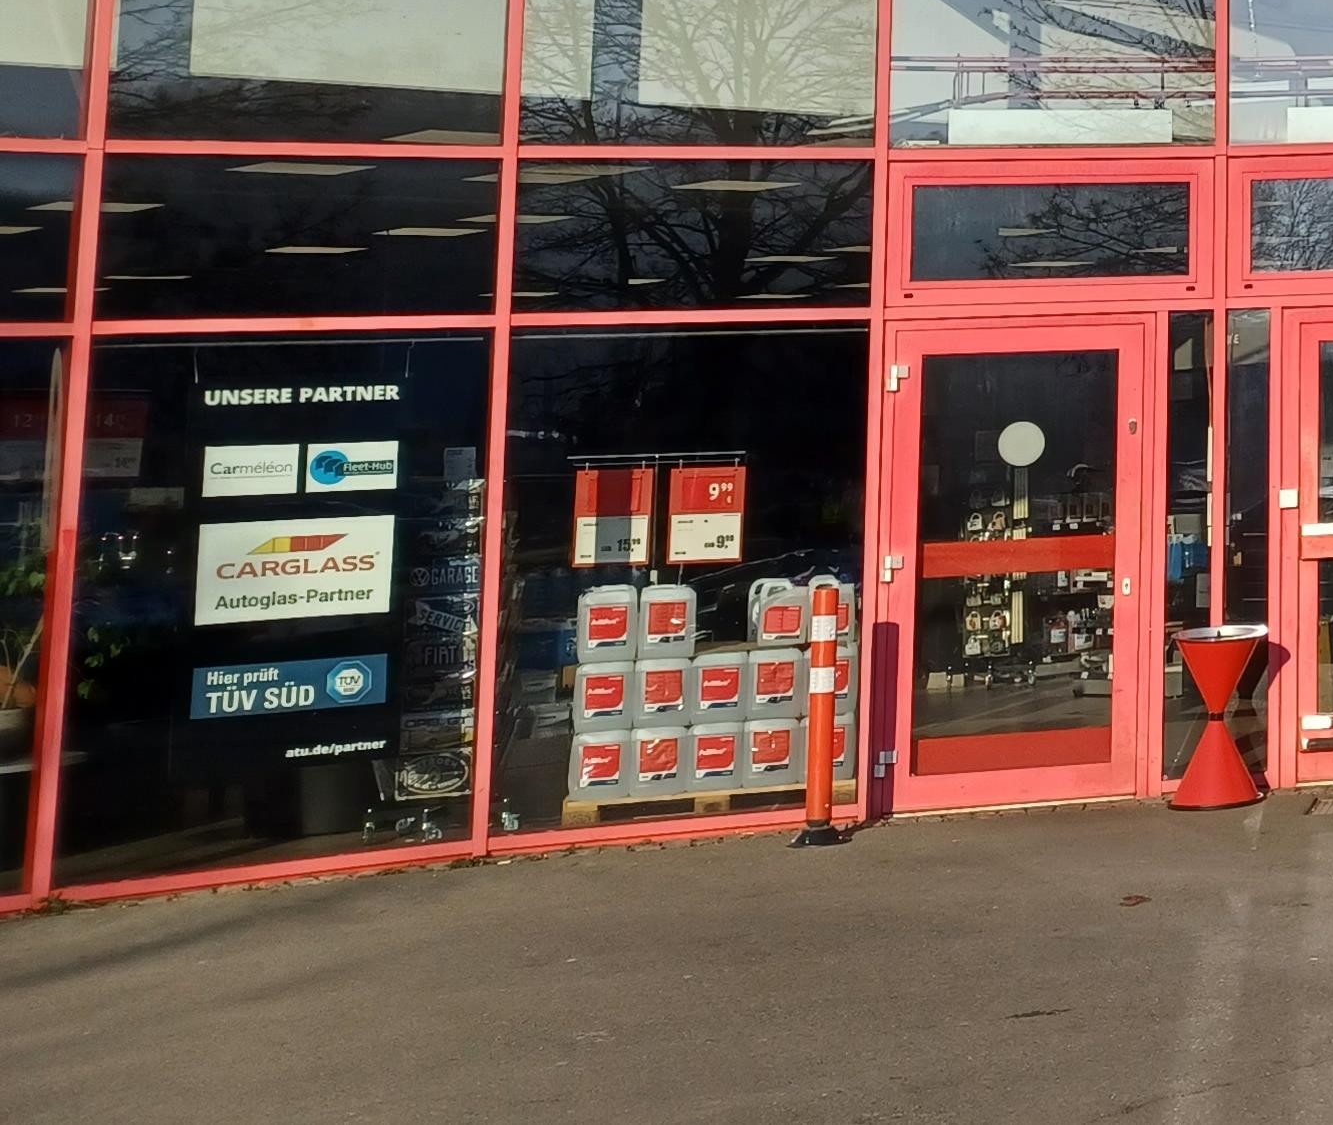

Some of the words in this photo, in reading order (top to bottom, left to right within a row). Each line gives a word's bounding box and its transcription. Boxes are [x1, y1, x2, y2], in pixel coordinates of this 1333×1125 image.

[204, 387, 293, 406] UNSERE
[299, 385, 400, 403] PARTNER
[210, 461, 293, 475] Carméléon
[343, 461, 394, 473] Fleet-Hub
[216, 554, 376, 580] CARGLASS
[430, 565, 479, 585] GARAGE
[214, 587, 374, 611] Autoglas-Partner
[424, 645, 458, 666] FIAT
[206, 671, 238, 686] Hier
[243, 667, 279, 687] prüft
[206, 685, 258, 714] TÜV
[263, 681, 316, 709] SÜD
[284, 739, 387, 759] atu.de/partner
